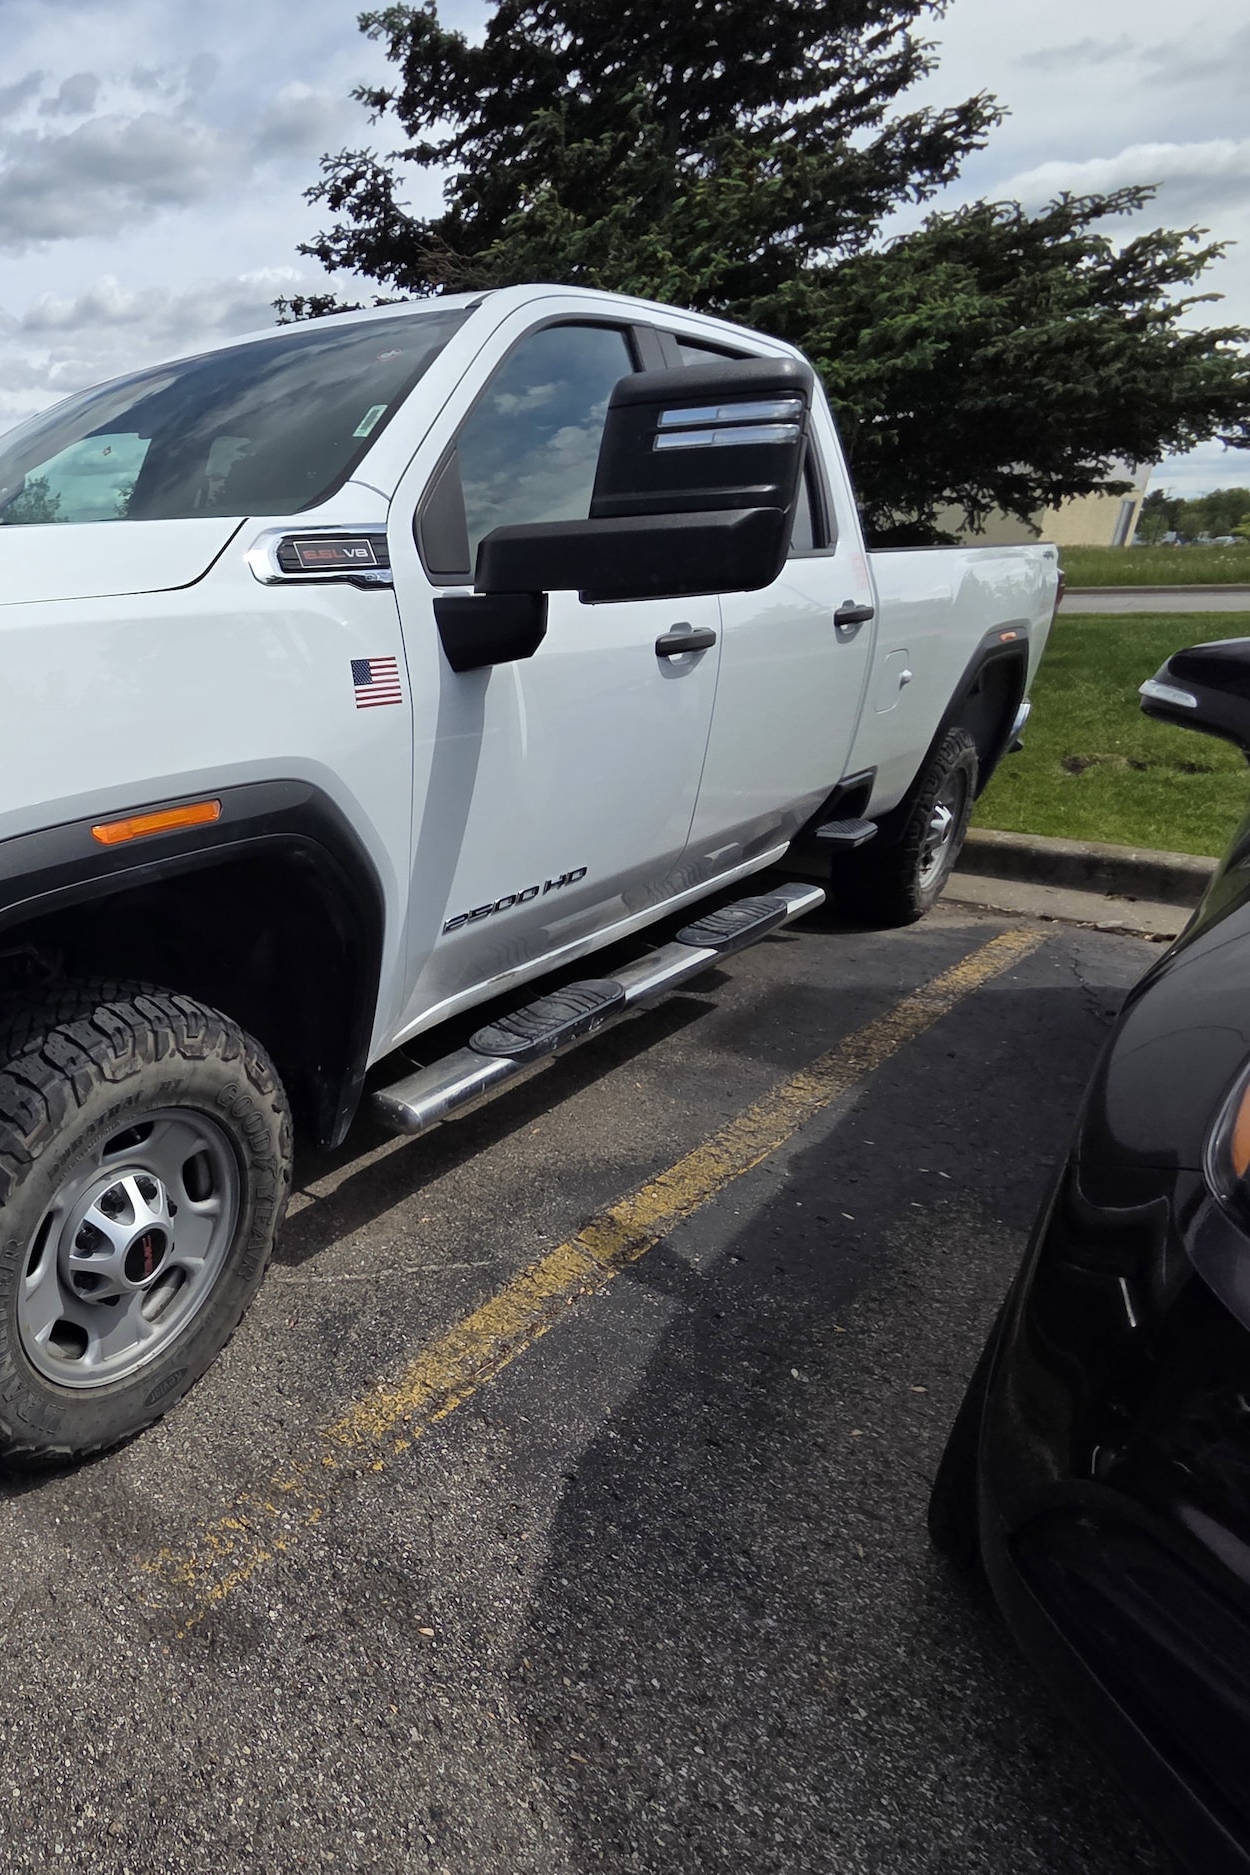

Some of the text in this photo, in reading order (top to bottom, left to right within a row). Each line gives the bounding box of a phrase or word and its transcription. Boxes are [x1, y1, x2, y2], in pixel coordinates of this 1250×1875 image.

[442, 866, 588, 935] 2500 HD
[217, 1082, 278, 1281] GOODYEAR
[142, 1235, 154, 1277] GMC
[150, 1370, 183, 1402] Kevlar
